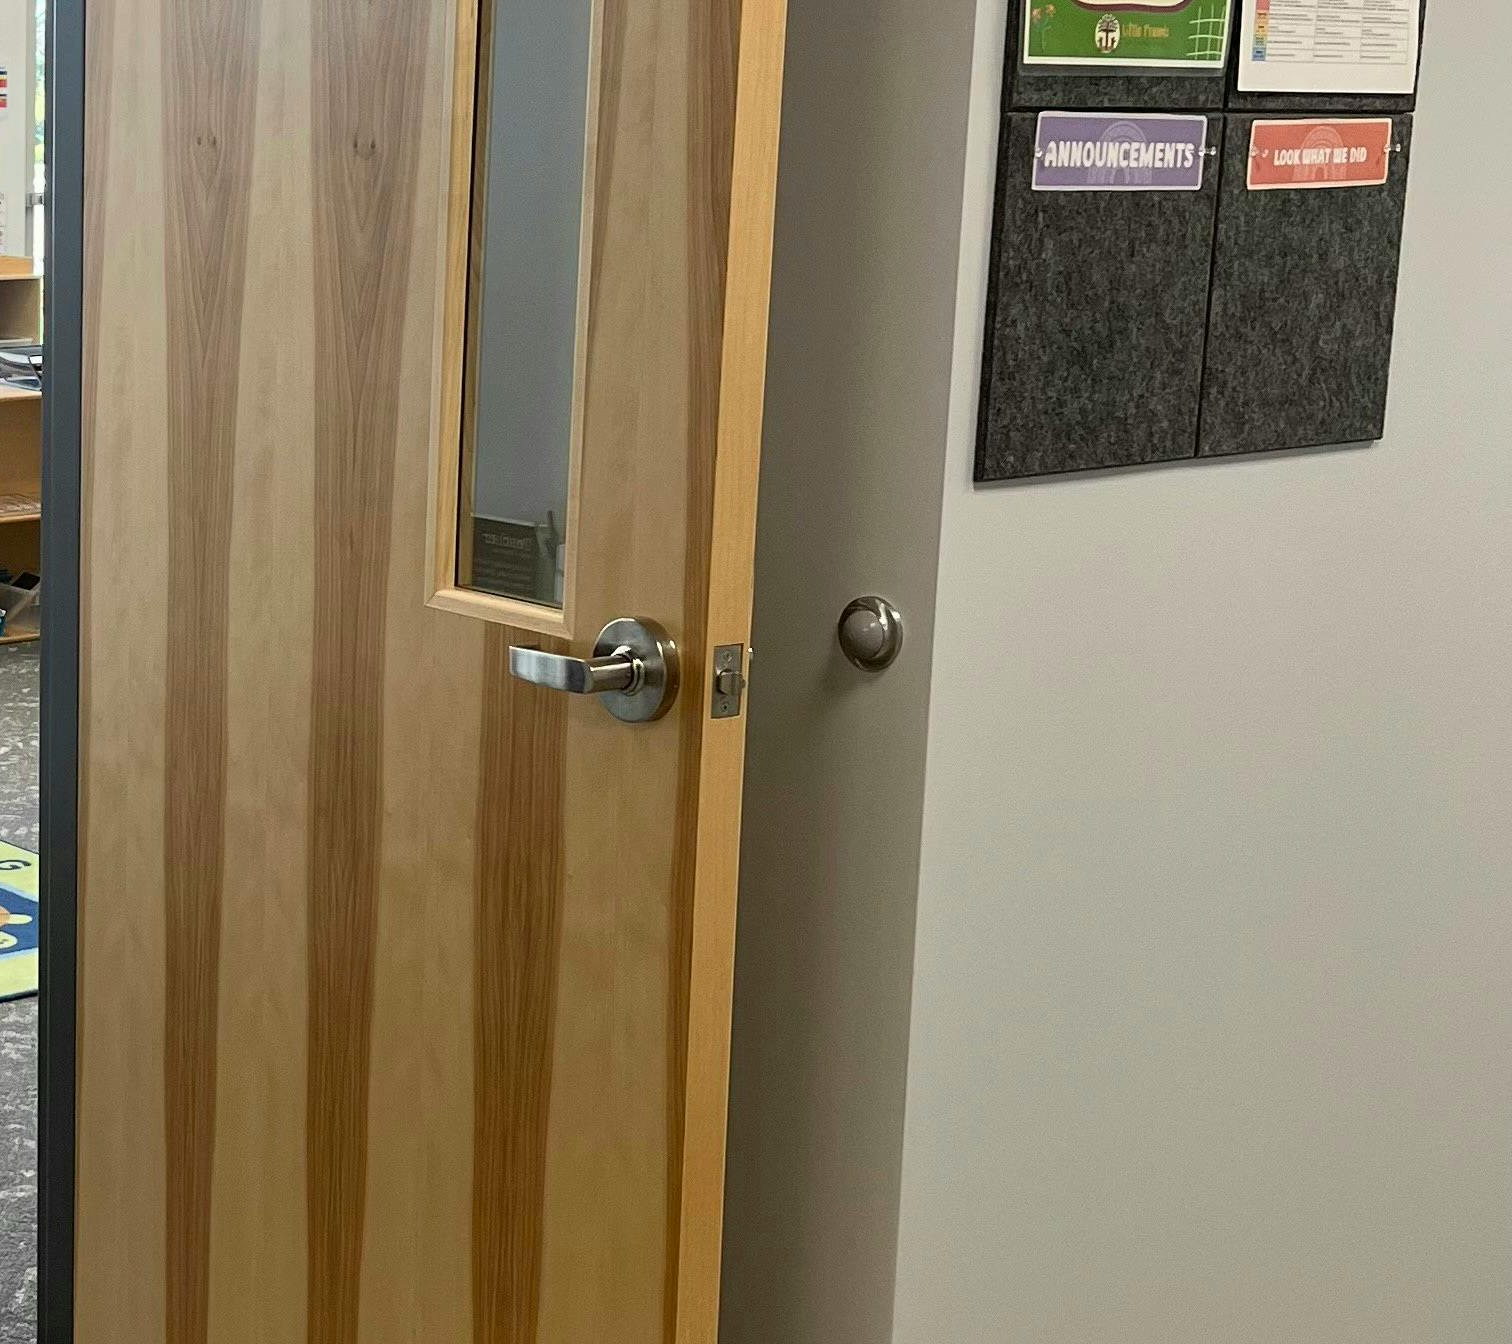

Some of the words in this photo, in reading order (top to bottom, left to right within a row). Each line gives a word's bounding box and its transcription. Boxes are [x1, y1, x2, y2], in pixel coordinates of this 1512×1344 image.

[1044, 141, 1196, 169] ANNOUNCEMENTS
[1273, 149, 1301, 166] LOOK
[1302, 147, 1331, 165] WHAT
[1333, 146, 1348, 164] WE
[1348, 146, 1367, 163] DID
